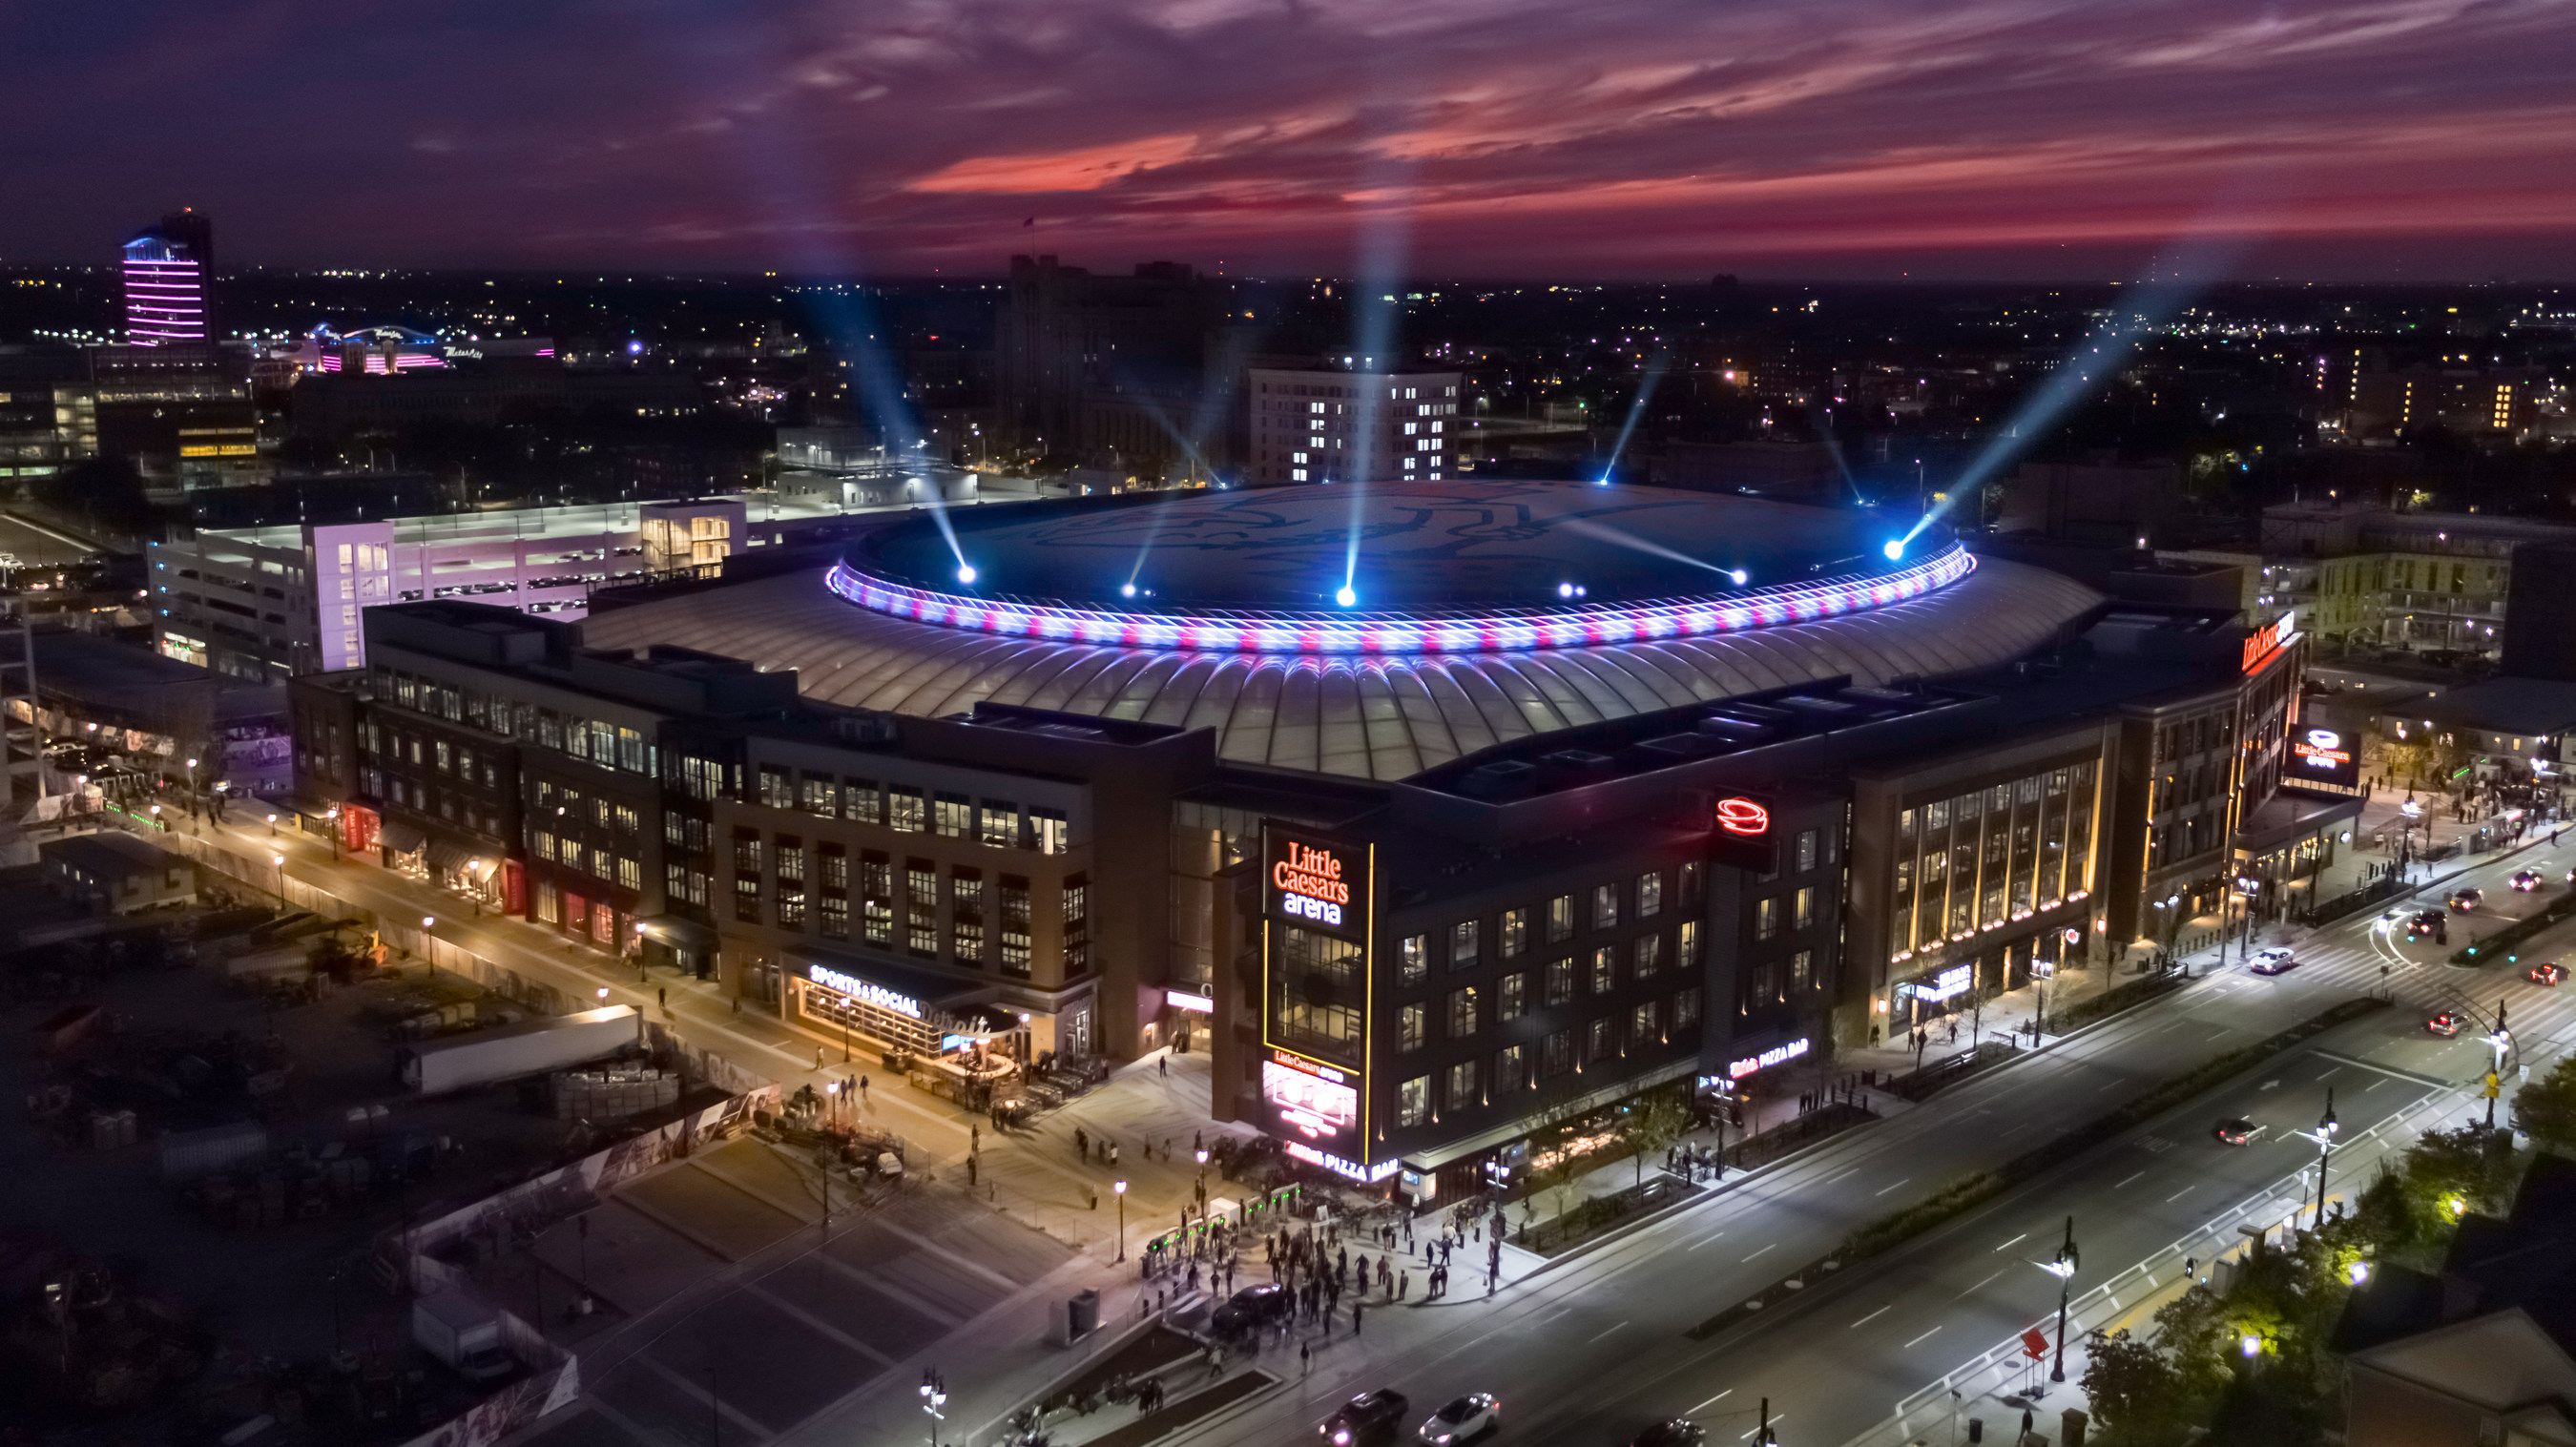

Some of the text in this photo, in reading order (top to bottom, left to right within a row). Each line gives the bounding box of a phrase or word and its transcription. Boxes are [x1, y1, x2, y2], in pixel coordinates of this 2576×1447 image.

[2294, 742, 2351, 763] Little Caesars
[1288, 841, 1341, 879] Little
[1274, 860, 1349, 904] Caesars
[1283, 892, 1341, 924] arena
[810, 964, 991, 1038] SPORTS & SOCIAL Detroit
[1275, 1049, 1295, 1065] Little
[1294, 1056, 1320, 1075] Caesars
[1758, 1046, 1788, 1068] PIZZA
[1787, 1038, 1809, 1059] BAR
[1324, 1153, 1368, 1182] PIZZA
